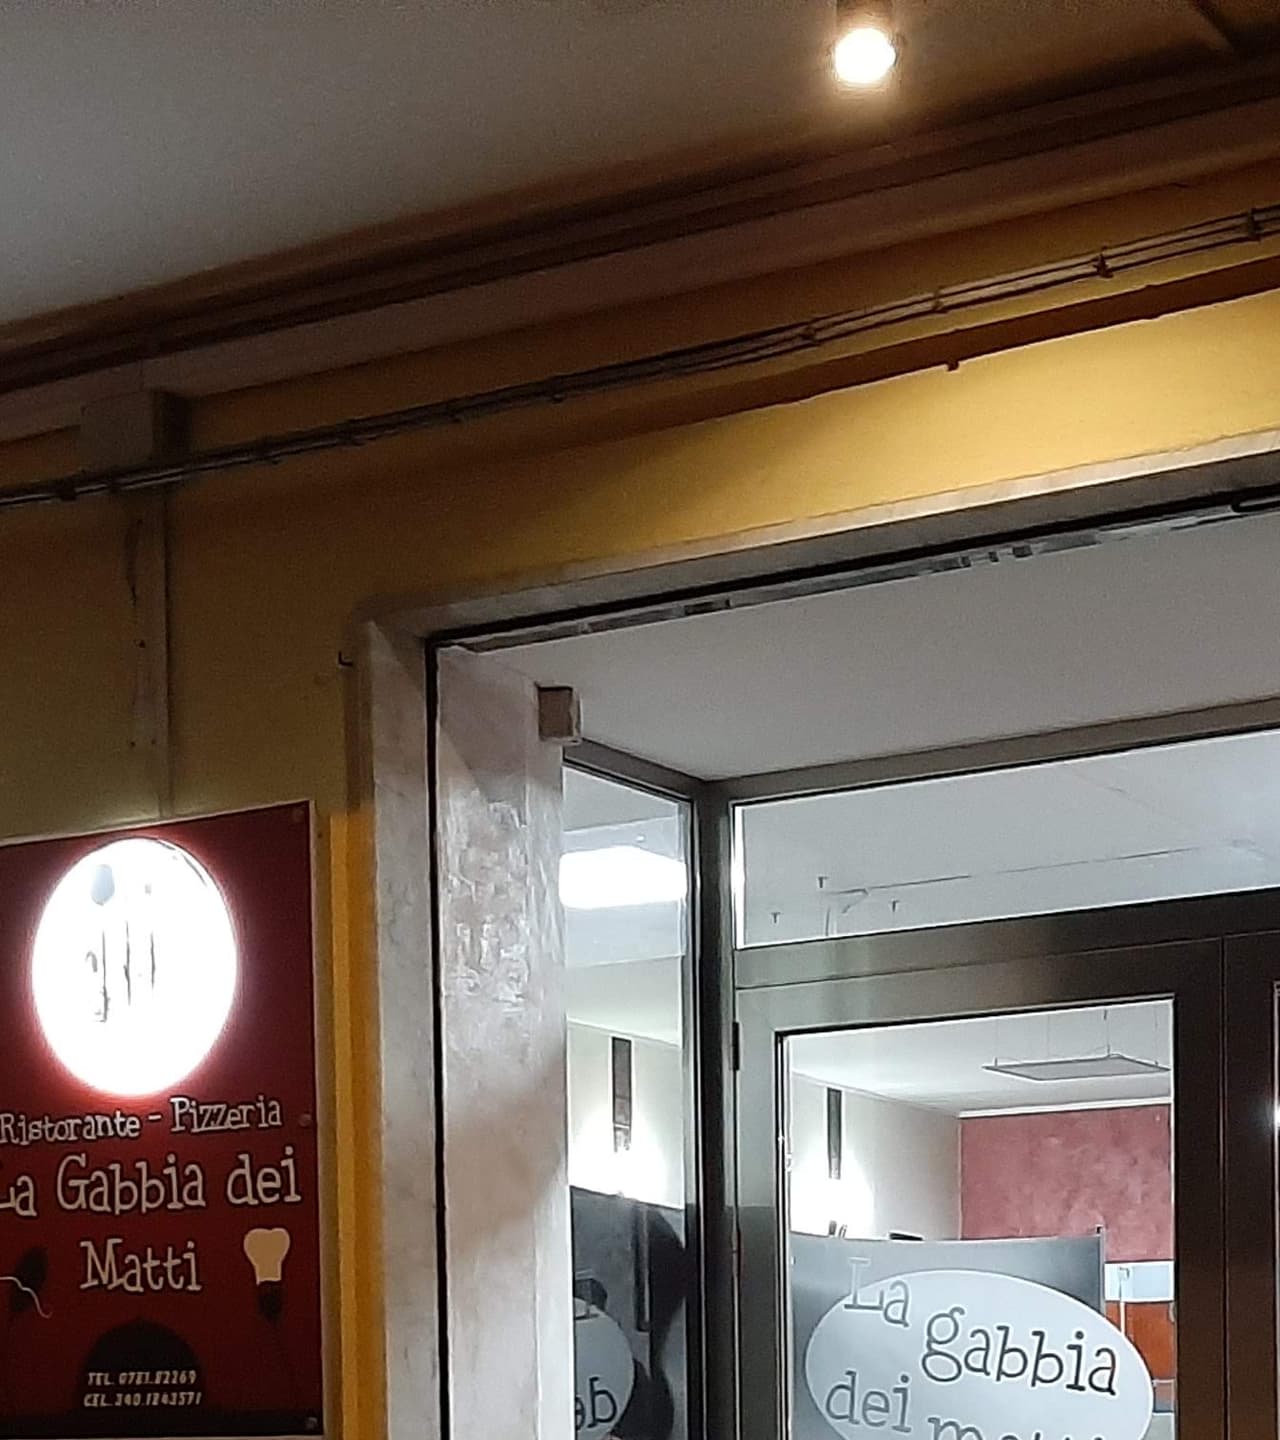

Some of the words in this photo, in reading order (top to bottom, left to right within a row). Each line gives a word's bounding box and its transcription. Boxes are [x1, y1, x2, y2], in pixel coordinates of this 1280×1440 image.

[169, 1095, 283, 1133] Pizzeria
[56, 1152, 206, 1215] Gabbia
[226, 1145, 303, 1206] dei
[79, 1237, 203, 1293] Matti
[843, 1256, 910, 1328] La
[921, 1306, 1117, 1397] gabbia
[825, 1370, 913, 1434] dei
